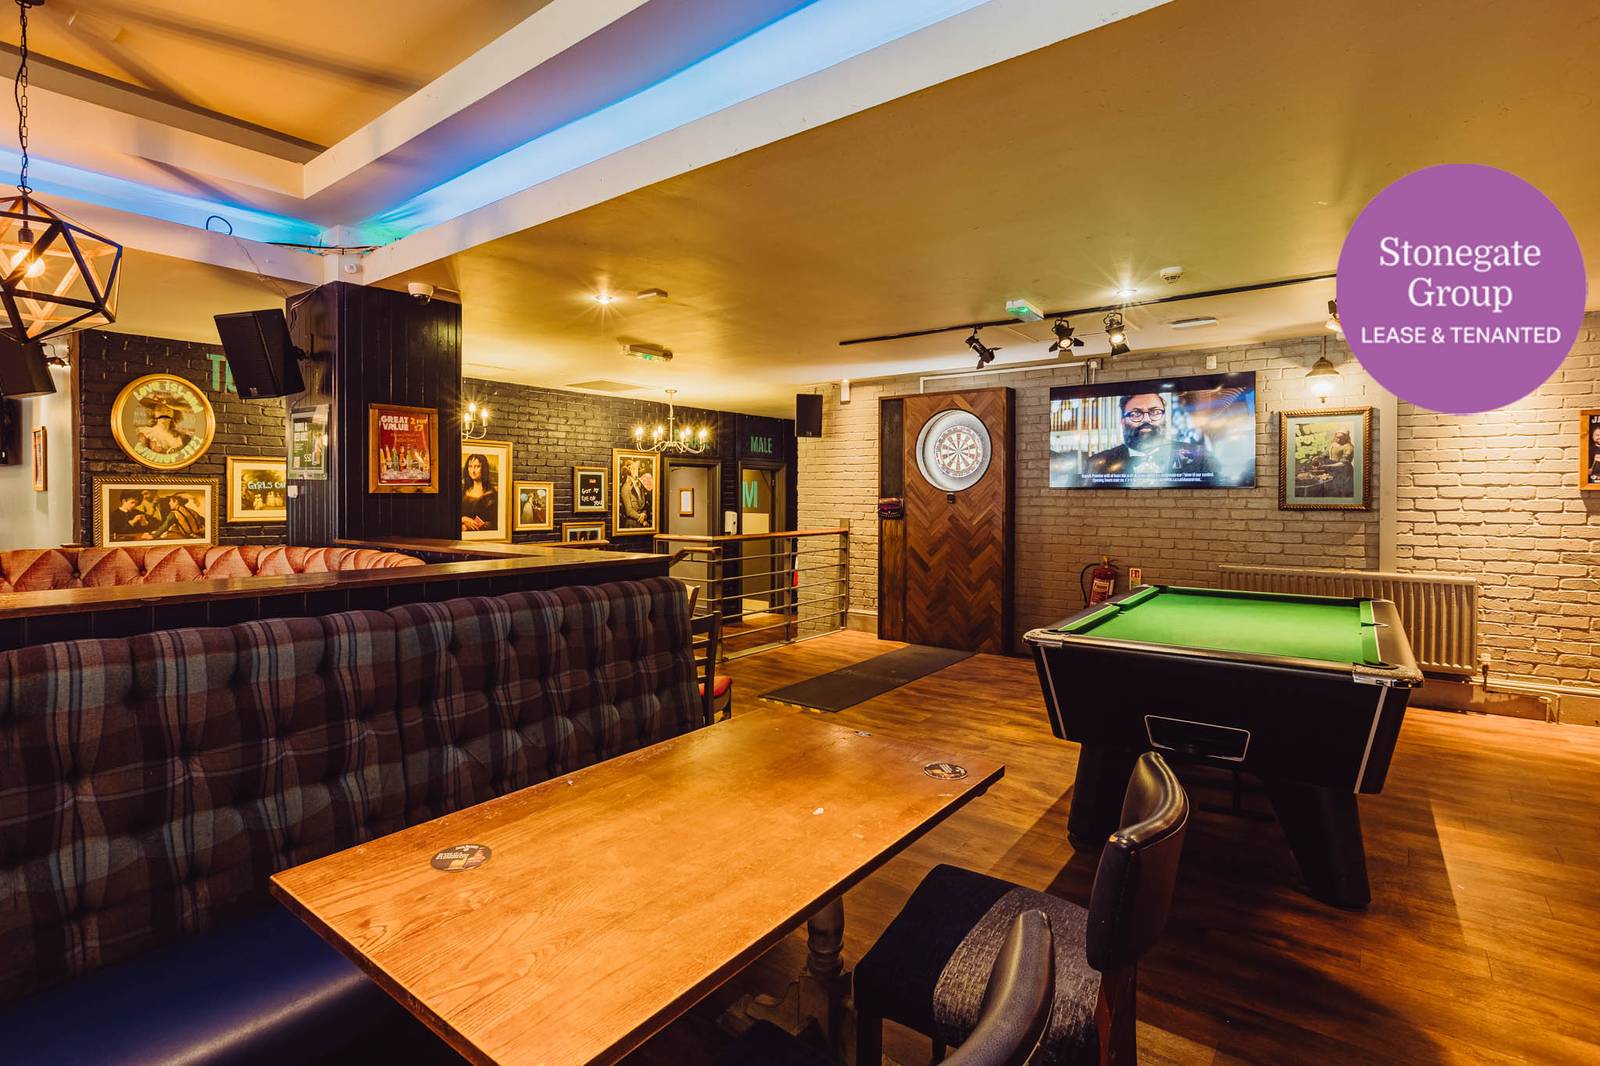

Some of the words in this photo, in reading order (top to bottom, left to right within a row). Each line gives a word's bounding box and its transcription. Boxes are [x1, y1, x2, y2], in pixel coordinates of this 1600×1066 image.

[380, 415, 409, 424] GREAT
[382, 422, 409, 431] VALUE
[750, 435, 773, 454] MALE
[742, 480, 759, 509] M
